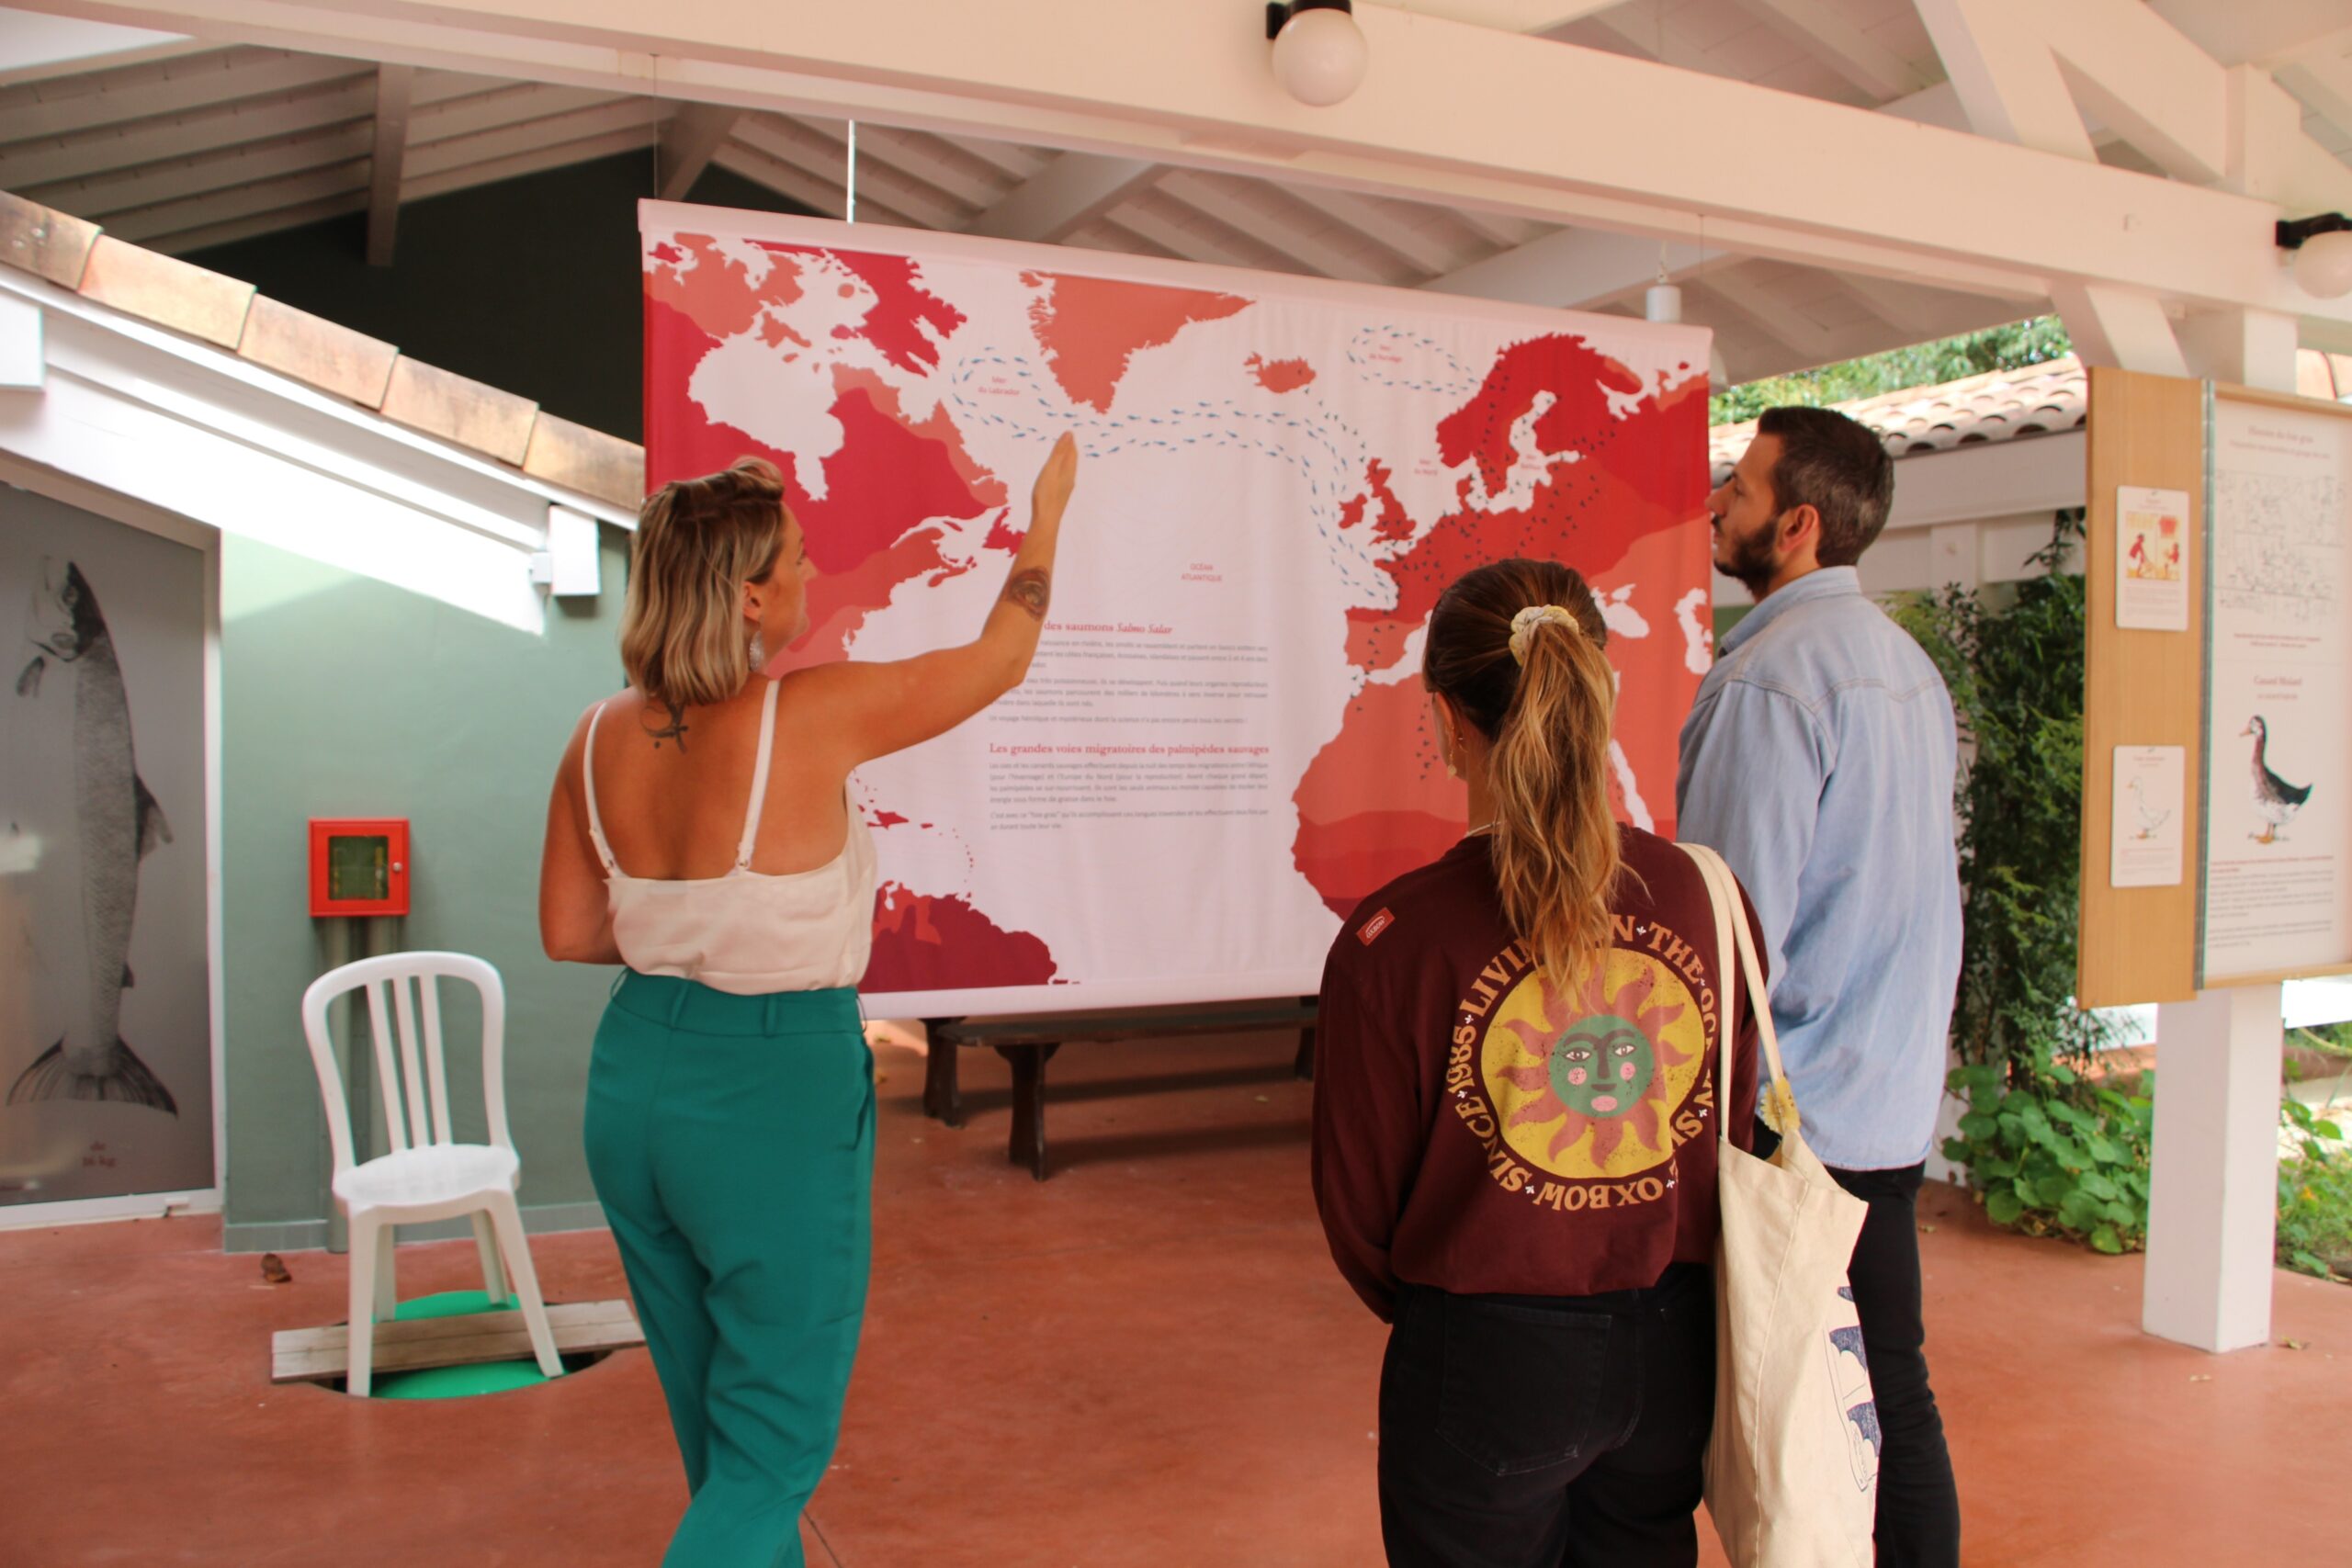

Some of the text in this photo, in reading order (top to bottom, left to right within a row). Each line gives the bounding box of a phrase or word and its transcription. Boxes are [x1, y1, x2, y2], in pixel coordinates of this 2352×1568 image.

[1044, 620, 1173, 635] des saumons Salmo Salar
[989, 743, 1270, 757] Les grandes voies migratoires des palmipèdes sauvages
[1648, 920, 1703, 985] THE
[1445, 1025, 1477, 1095] 1985
[1454, 1095, 1533, 1192] SINCE
[1532, 1177, 1664, 1212] OXBOW
